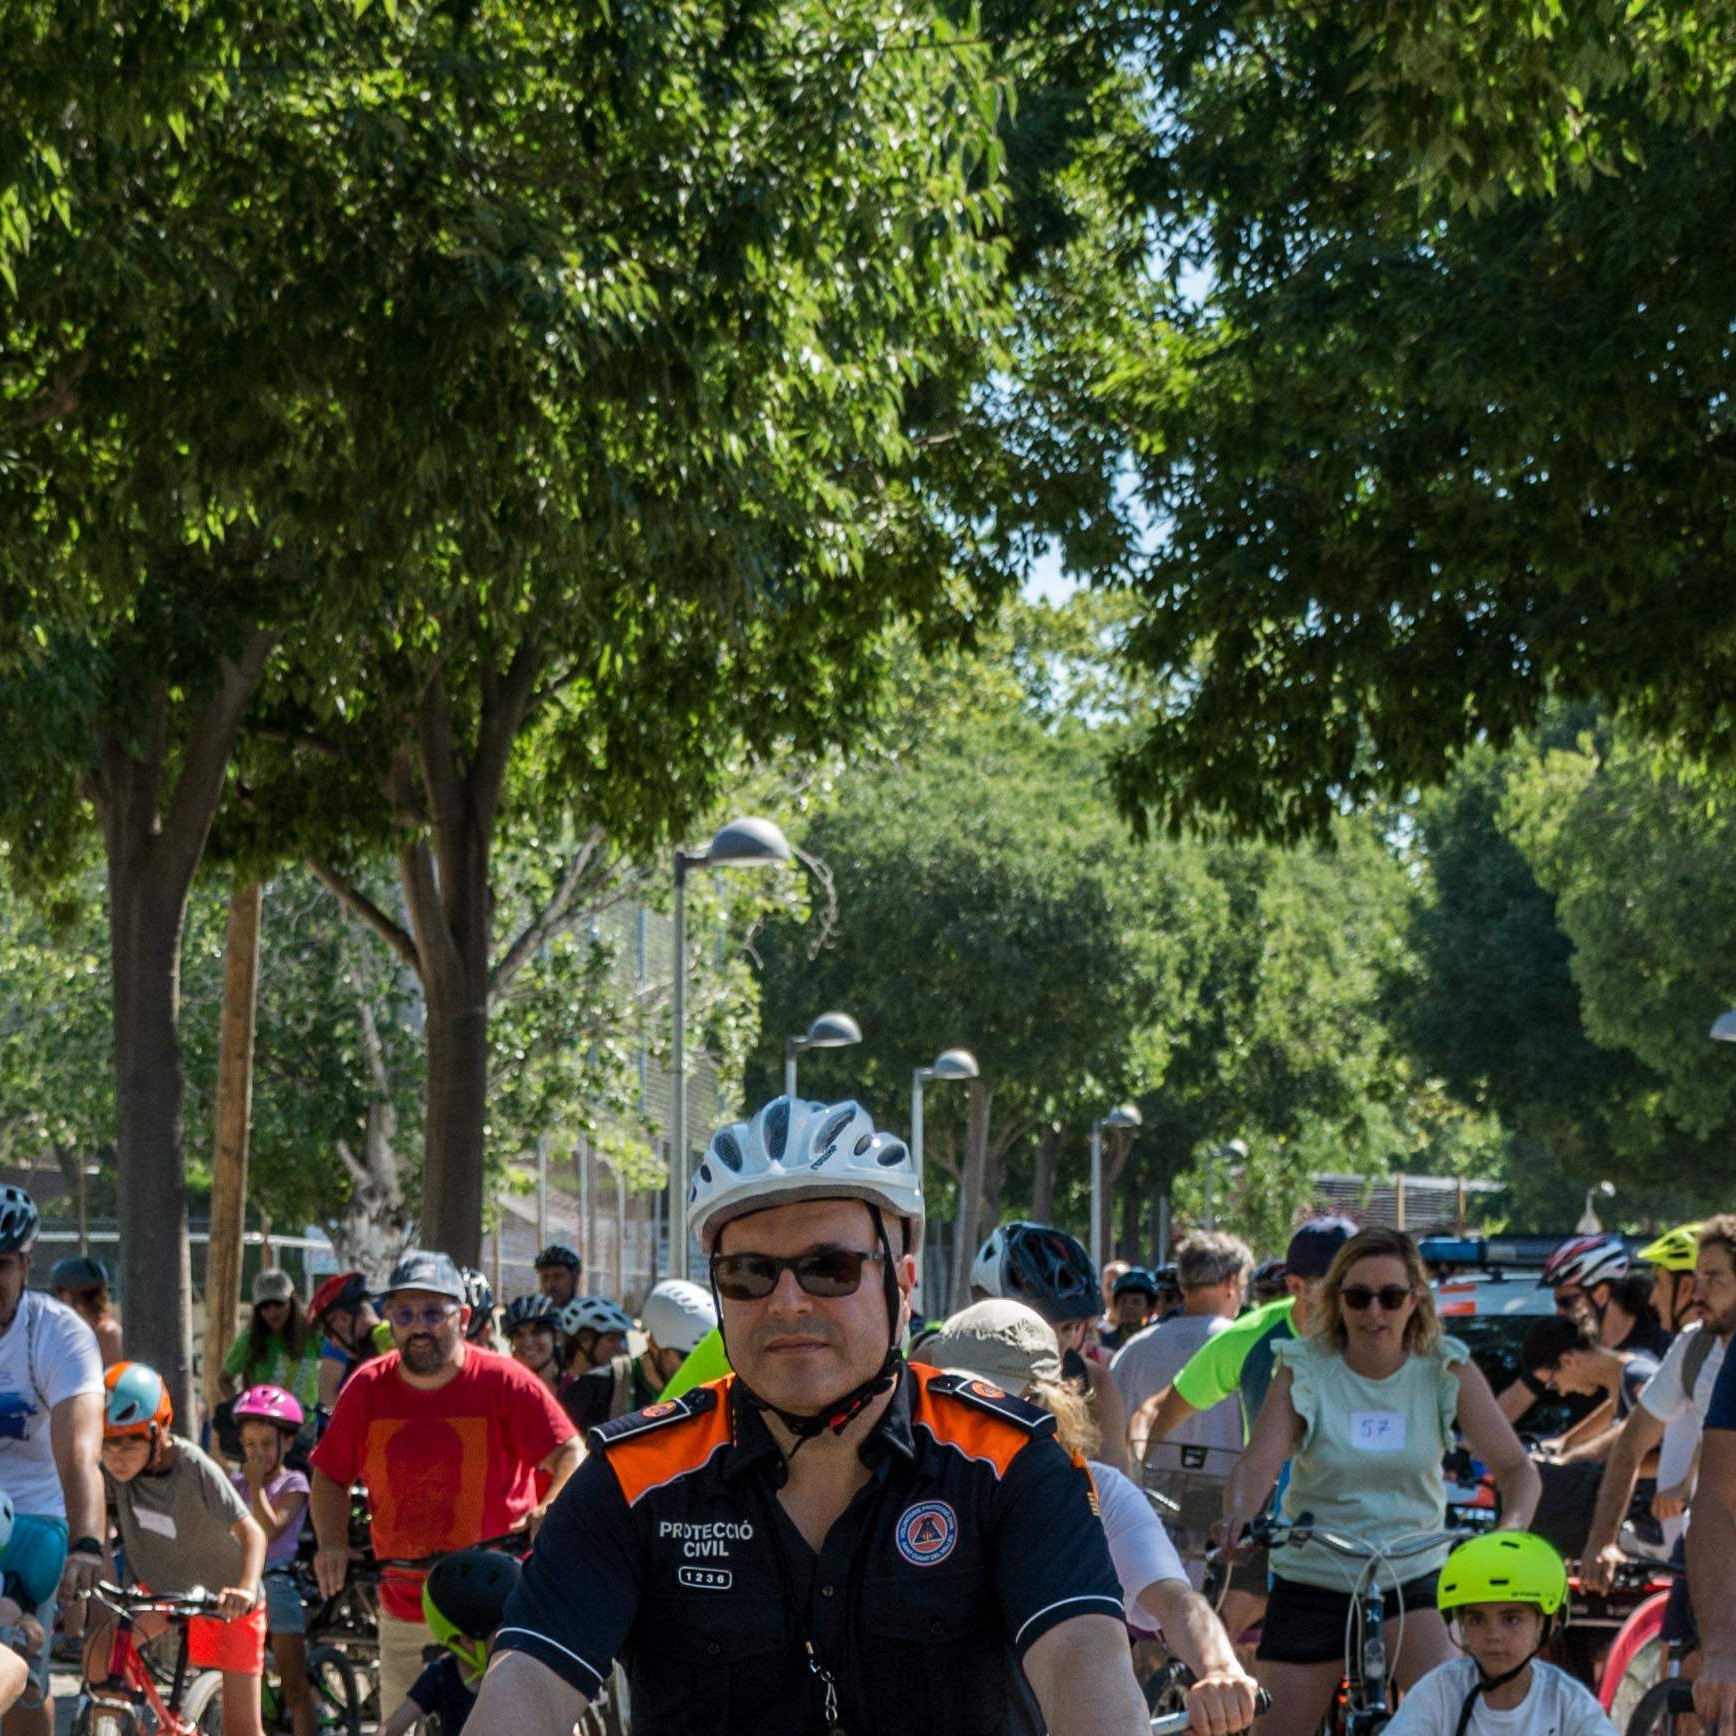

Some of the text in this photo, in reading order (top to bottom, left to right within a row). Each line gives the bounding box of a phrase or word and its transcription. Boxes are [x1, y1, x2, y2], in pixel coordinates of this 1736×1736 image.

[1361, 1419, 1392, 1438] 57
[659, 1519, 753, 1540] PROTECCIÓ
[683, 1540, 730, 1557] CIVIL
[684, 1572, 725, 1584] 1236
